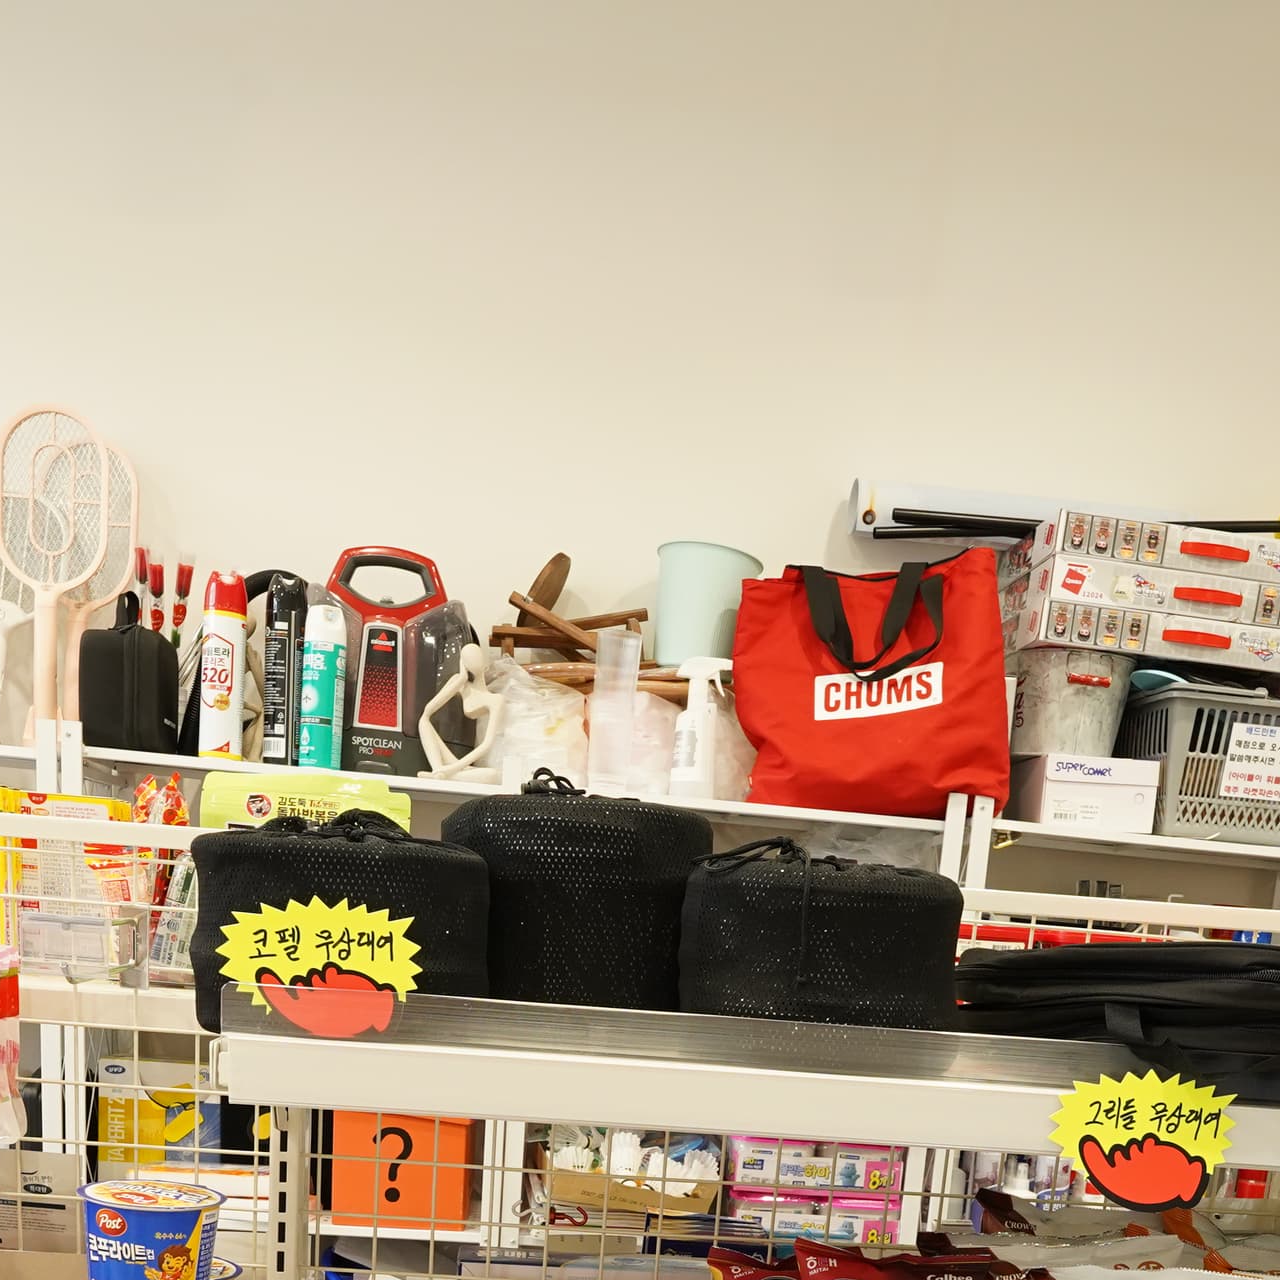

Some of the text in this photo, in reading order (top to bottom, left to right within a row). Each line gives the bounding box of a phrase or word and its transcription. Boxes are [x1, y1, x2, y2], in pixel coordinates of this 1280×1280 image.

[823, 669, 934, 713] CHUMS
[351, 735, 403, 751] SPOTCLEAN
[1235, 739, 1266, 750] 매점으로
[248, 924, 301, 962] 코펠
[1084, 1096, 1222, 1141] 그리들 무상대여
[97, 1211, 127, 1233] Post
